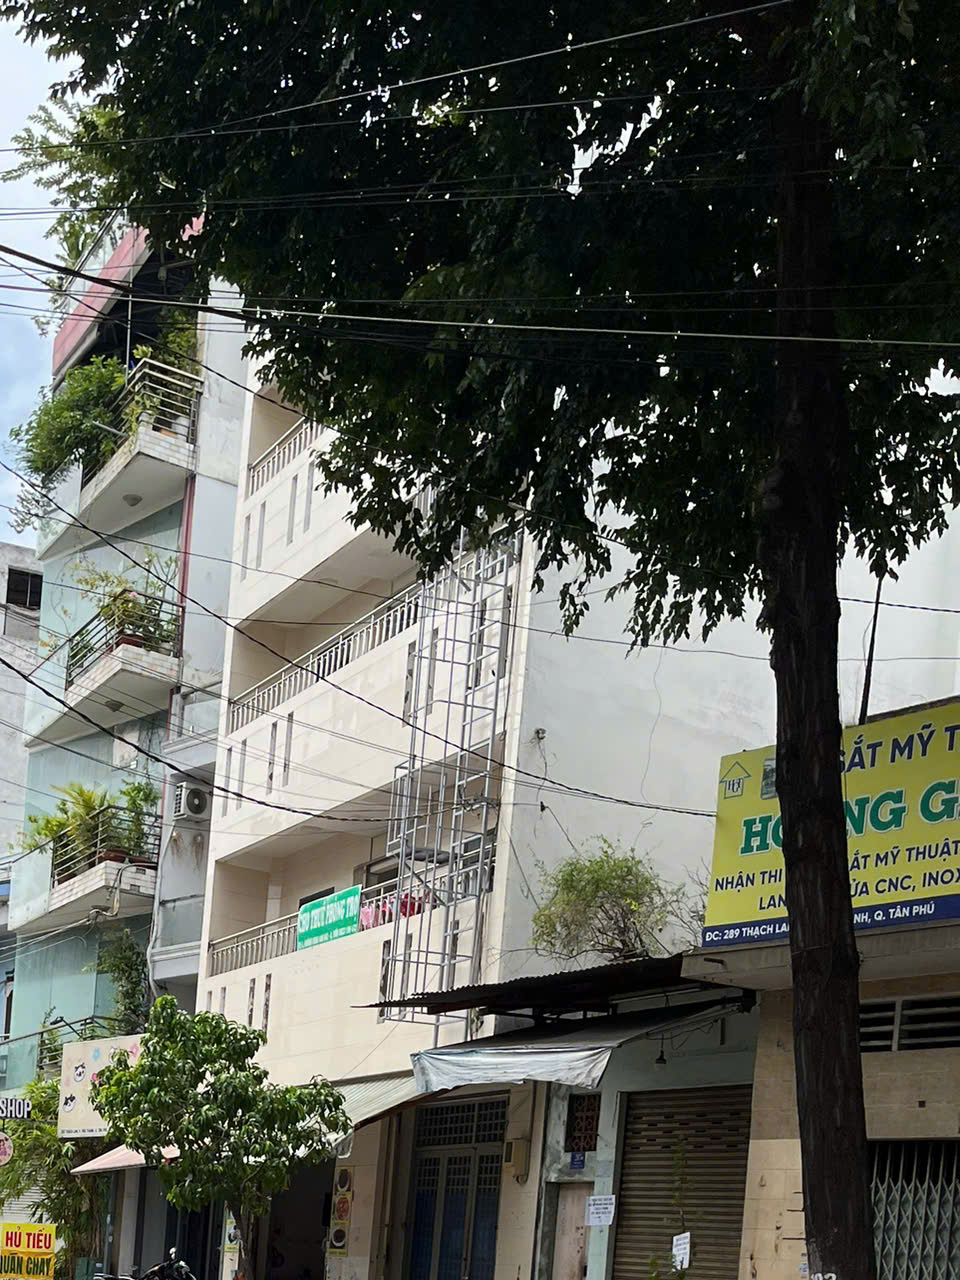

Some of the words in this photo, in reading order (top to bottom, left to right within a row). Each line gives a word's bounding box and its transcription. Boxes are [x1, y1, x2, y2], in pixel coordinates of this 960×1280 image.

[889, 722, 937, 764] MỸ
[714, 870, 756, 893] NHẬN
[759, 868, 783, 885] THI
[848, 850, 871, 872] ẮT
[874, 846, 901, 868] MỸ
[905, 838, 960, 863] THUẬT
[874, 875, 916, 894] CNC,
[873, 910, 886, 921] Q.
[888, 905, 910, 919] TÂN
[912, 900, 935, 916] PHÚ
[705, 931, 722, 942] ĐC:
[723, 928, 741, 940] 289
[741, 924, 774, 938] THẠCH
[0, 1098, 32, 1119] SHOP
[5, 1226, 22, 1248] HỦ
[25, 1227, 52, 1250] TIẾU
[26, 1255, 51, 1276] CHAY
